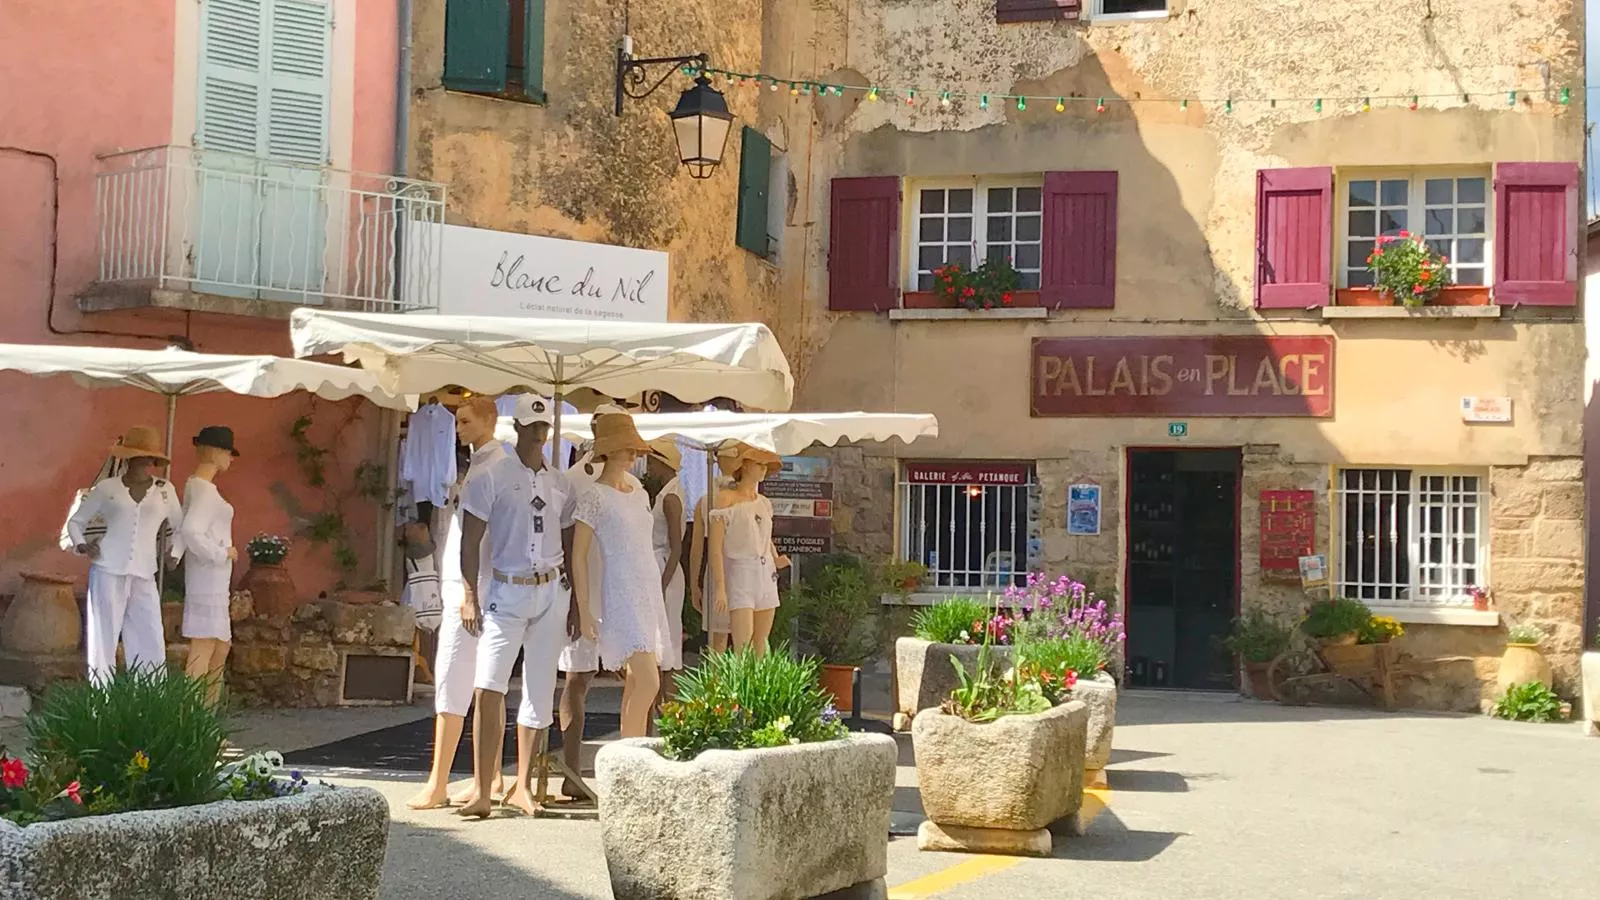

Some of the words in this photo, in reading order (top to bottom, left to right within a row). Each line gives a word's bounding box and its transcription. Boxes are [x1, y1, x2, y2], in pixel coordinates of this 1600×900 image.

[490, 250, 562, 293] Blanc
[571, 266, 602, 298] du
[611, 269, 655, 304] Nil
[574, 306, 583, 315] de
[585, 307, 592, 316] la
[1038, 354, 1173, 397] PALAIS
[1176, 367, 1201, 383] en
[1203, 354, 1325, 396] PLACE
[1172, 424, 1184, 435] 19
[914, 472, 946, 481] GALERIE
[978, 473, 1019, 482] PETANQUE
